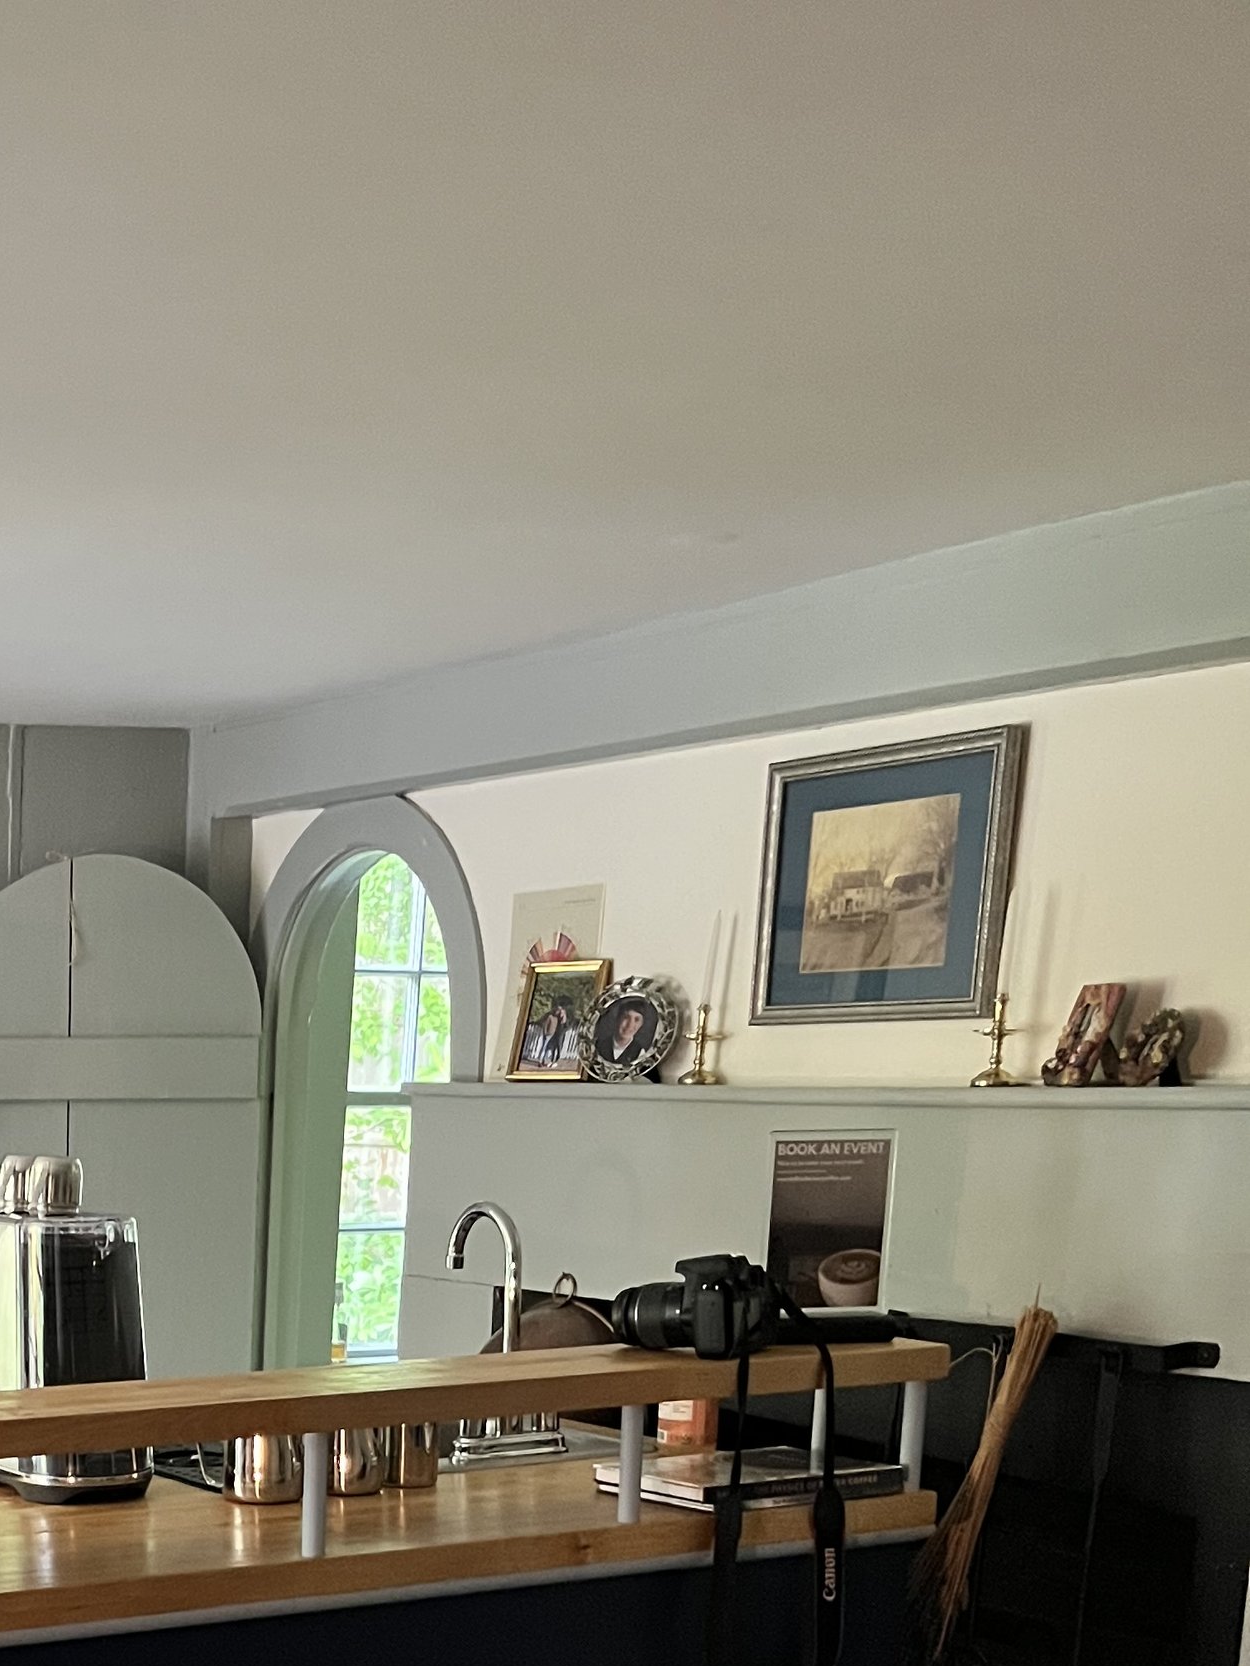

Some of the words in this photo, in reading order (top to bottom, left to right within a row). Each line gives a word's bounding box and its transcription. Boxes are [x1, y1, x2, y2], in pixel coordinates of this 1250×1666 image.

[778, 1143, 817, 1155] BOOK
[820, 1142, 840, 1155] AN
[844, 1142, 884, 1154] EVENT
[823, 1548, 836, 1601] Canon
